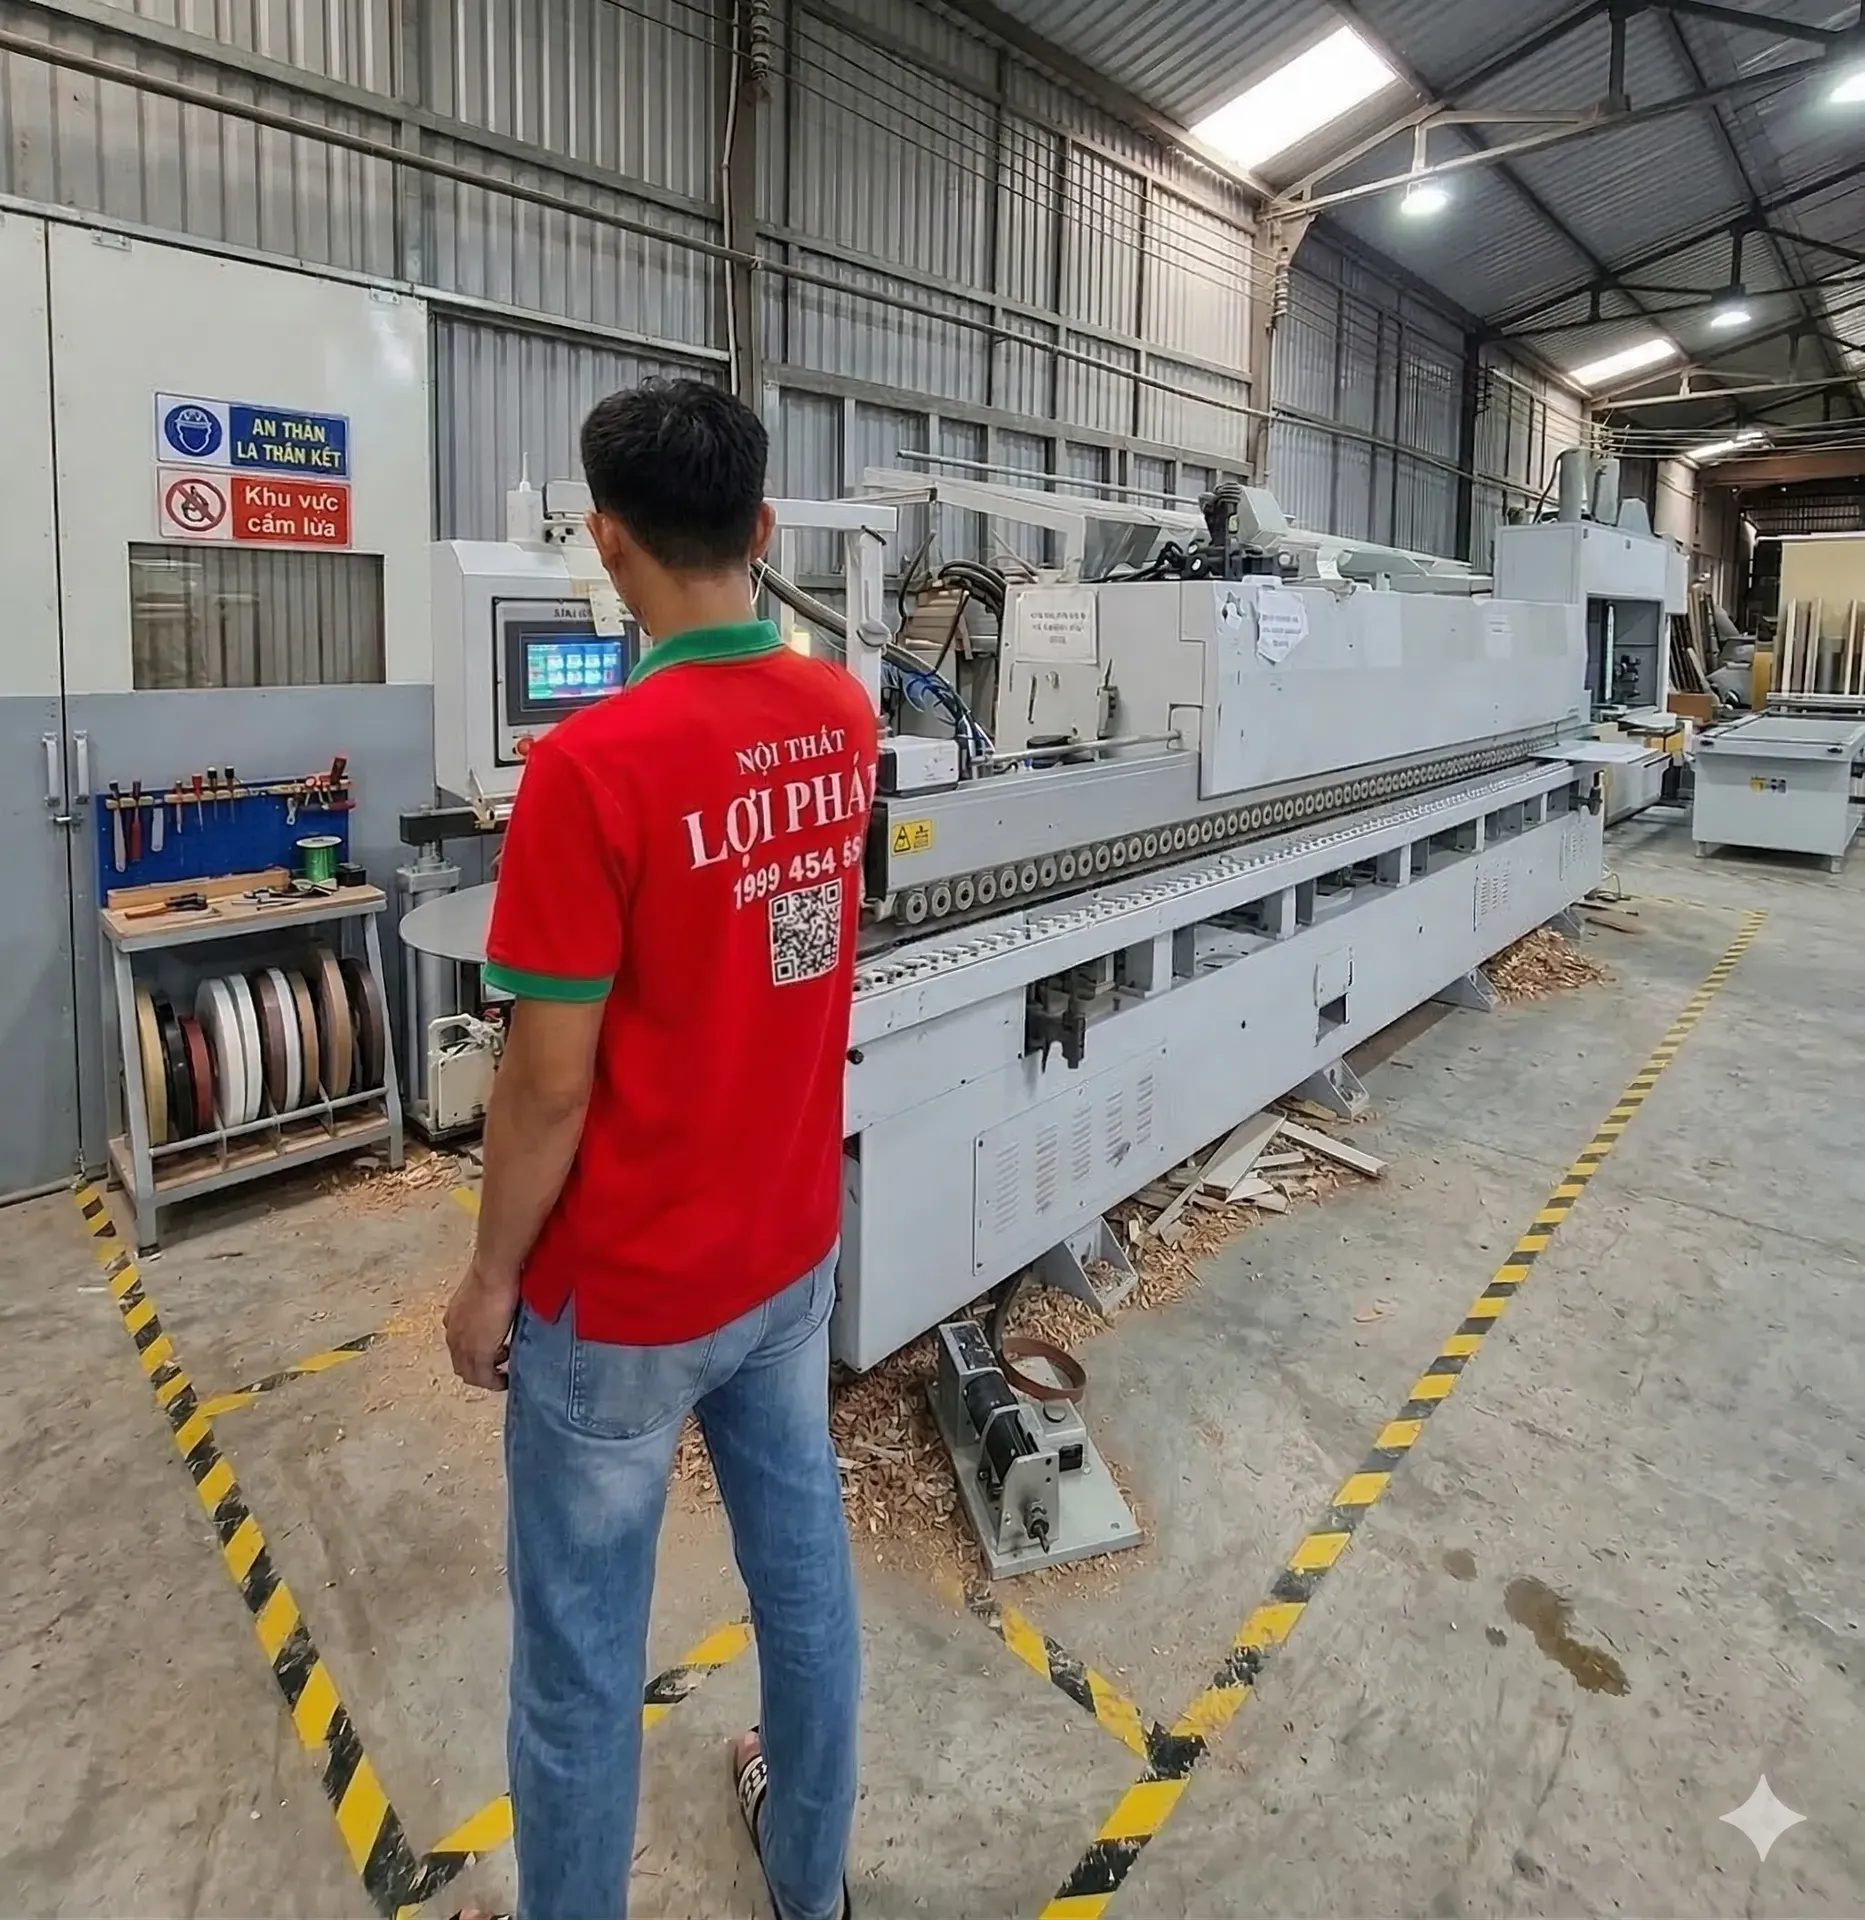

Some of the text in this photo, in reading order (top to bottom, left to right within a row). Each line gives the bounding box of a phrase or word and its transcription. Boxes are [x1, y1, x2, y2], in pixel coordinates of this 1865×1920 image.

[252, 418, 277, 437] AN
[236, 441, 259, 460] LA
[245, 485, 339, 515] Khu vực
[247, 510, 296, 535] cấm
[735, 724, 846, 776] NỘI THẤT
[682, 787, 777, 870] LỢI
[733, 862, 781, 910] 1999
[788, 847, 836, 882] 454
